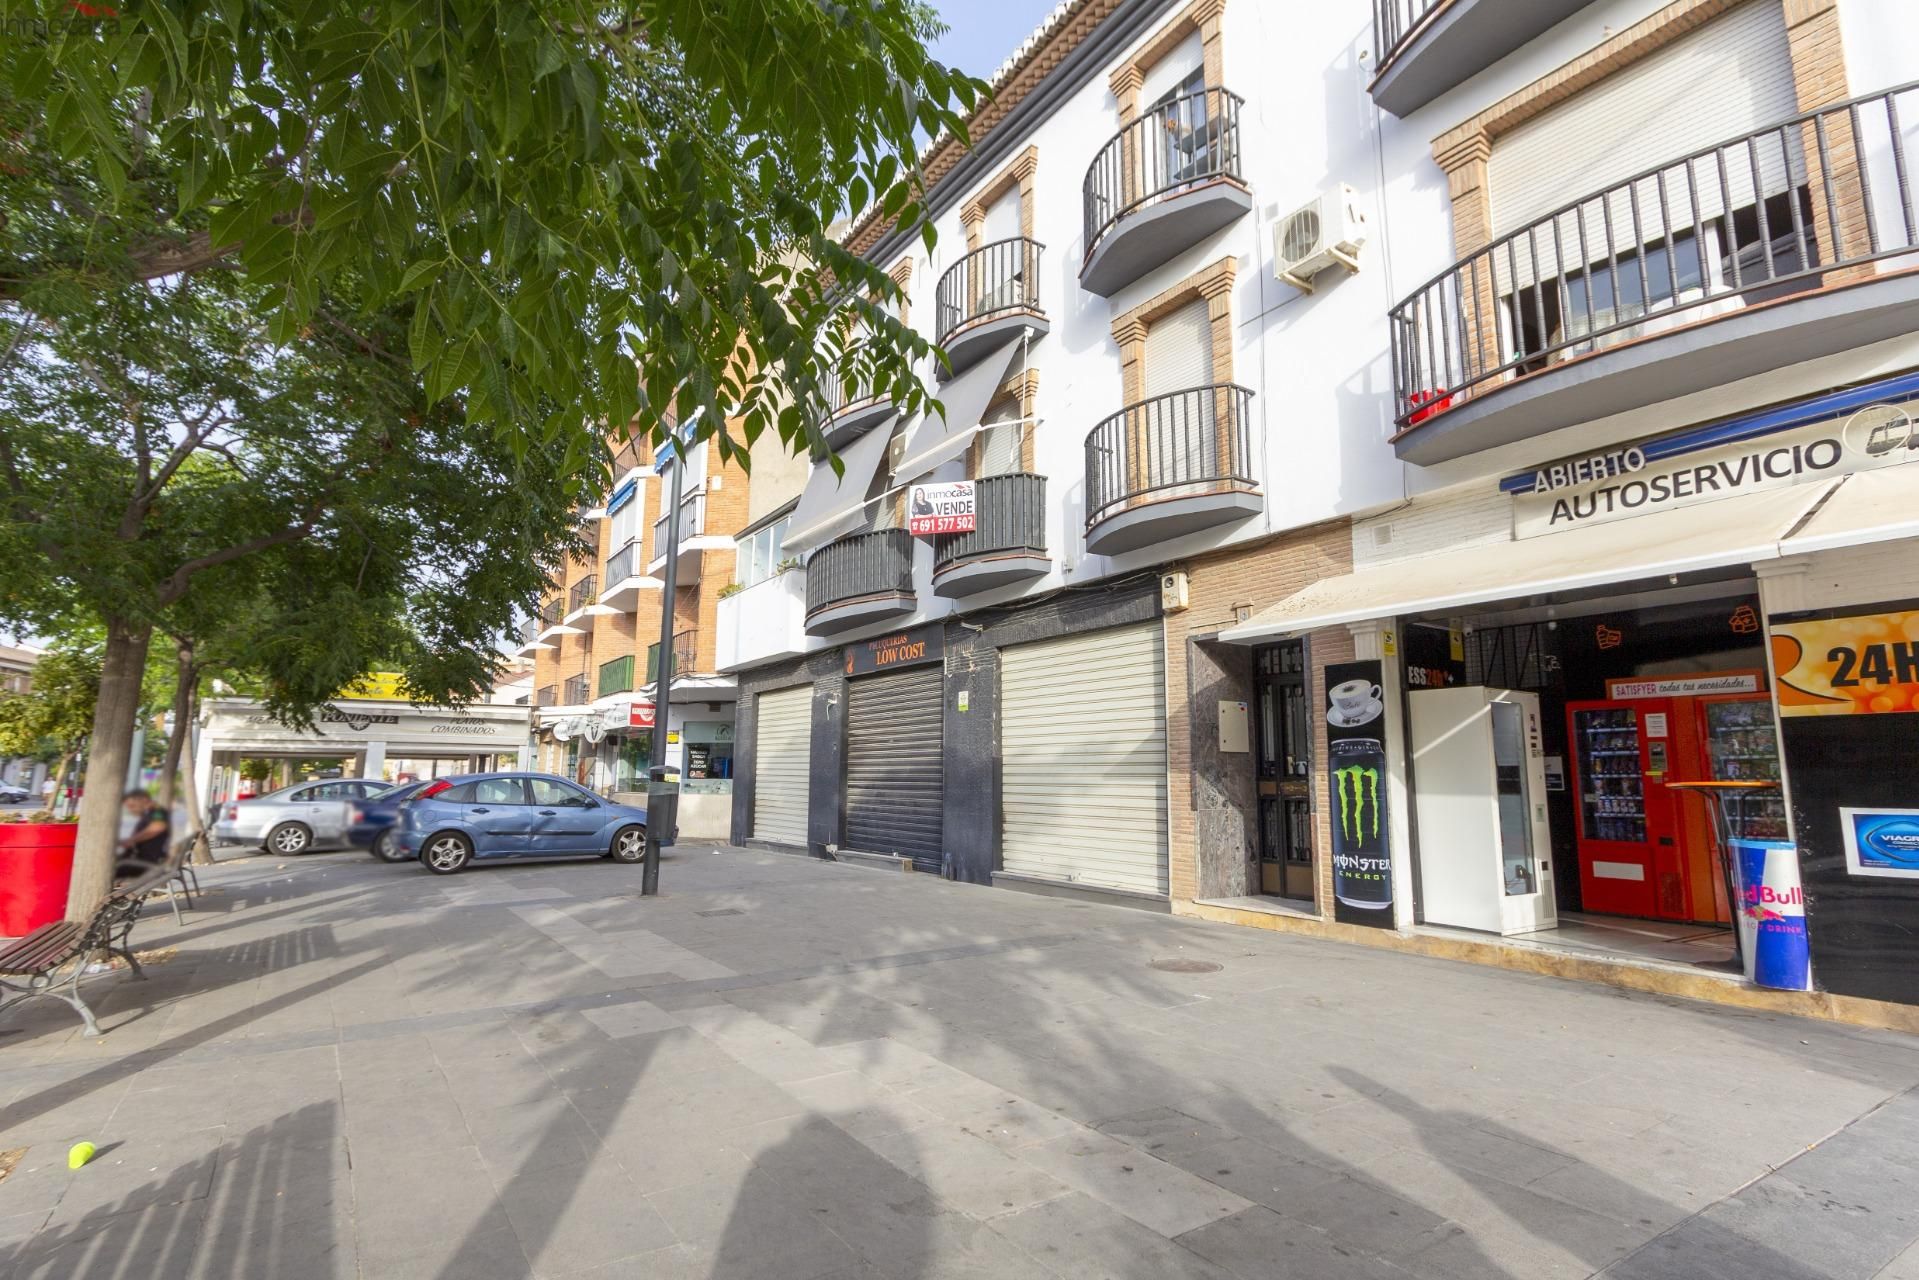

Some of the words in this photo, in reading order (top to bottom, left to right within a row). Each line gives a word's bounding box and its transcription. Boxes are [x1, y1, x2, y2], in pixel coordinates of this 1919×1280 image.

[1533, 446, 1647, 494] ABIERTO
[1549, 437, 1843, 525] AUTOSERVICIO
[927, 488, 973, 500] inmocasa
[936, 500, 973, 515] VENDE
[919, 518, 935, 532] 691
[937, 518, 955, 531] 577
[956, 516, 973, 529] 502
[876, 647, 899, 665] LOW
[899, 641, 926, 661] COST
[1826, 641, 1919, 688] 24H
[1616, 683, 1657, 697] SATISFYER
[324, 712, 396, 724] PONIENTE
[431, 725, 496, 735] COMBINADOS
[1333, 854, 1392, 871] MONSTER
[1339, 871, 1387, 881] ENERGY
[1760, 885, 1802, 905] Bull
